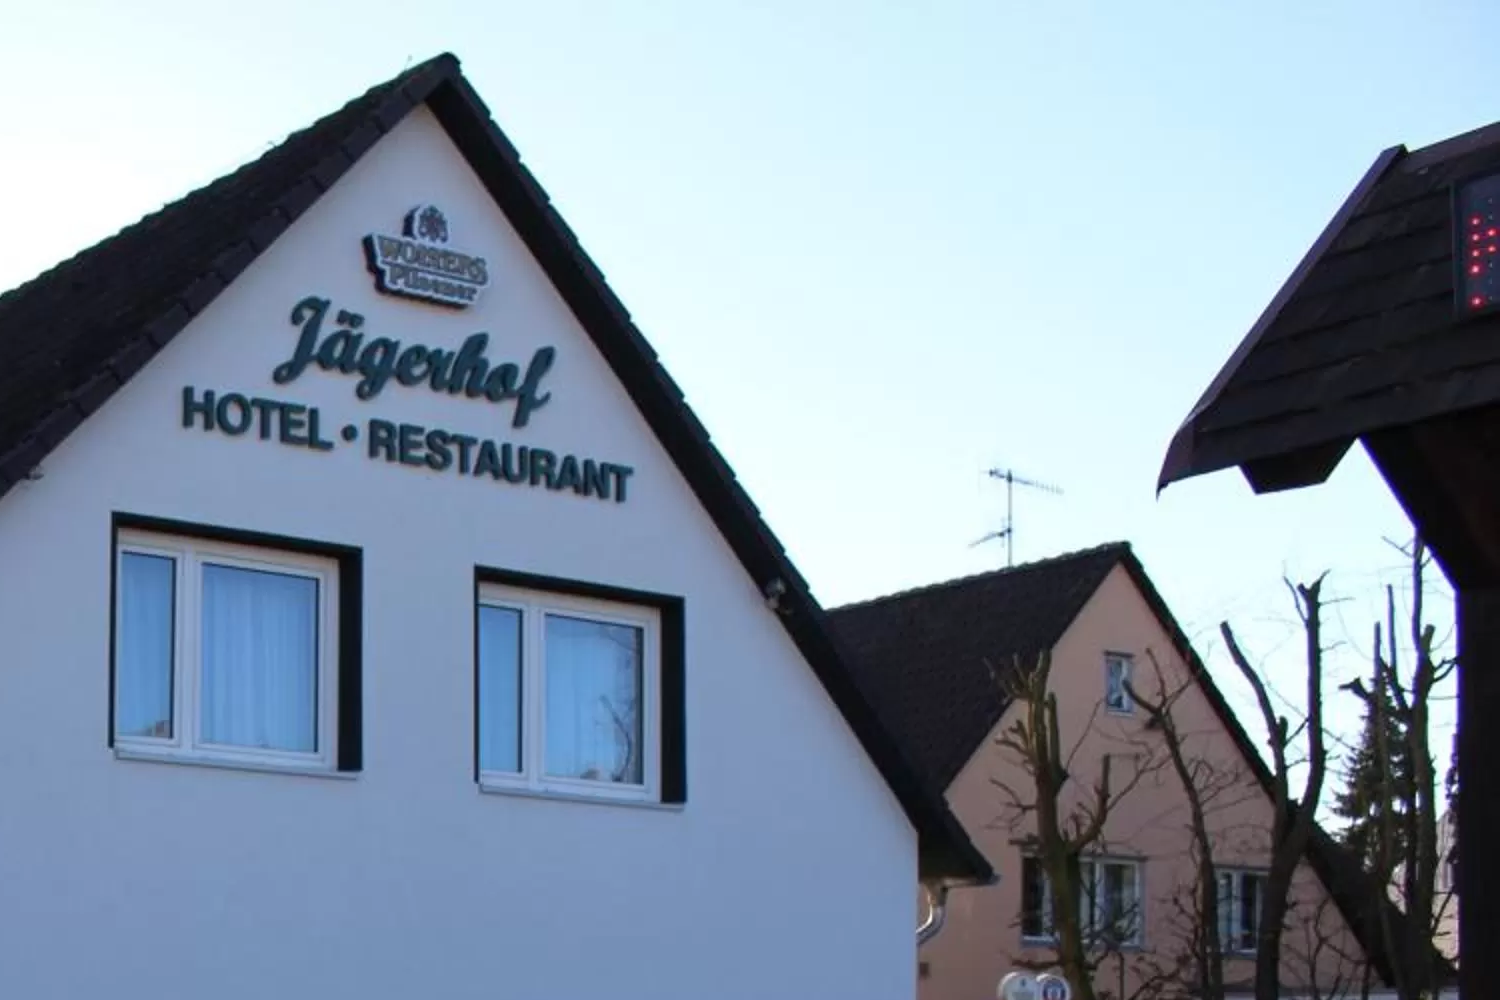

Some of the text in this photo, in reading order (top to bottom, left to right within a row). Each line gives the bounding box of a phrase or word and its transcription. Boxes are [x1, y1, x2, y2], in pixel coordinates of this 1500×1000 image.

[272, 296, 556, 429] Jägerhof
[182, 385, 634, 502] HOTEL RESTAURANT
